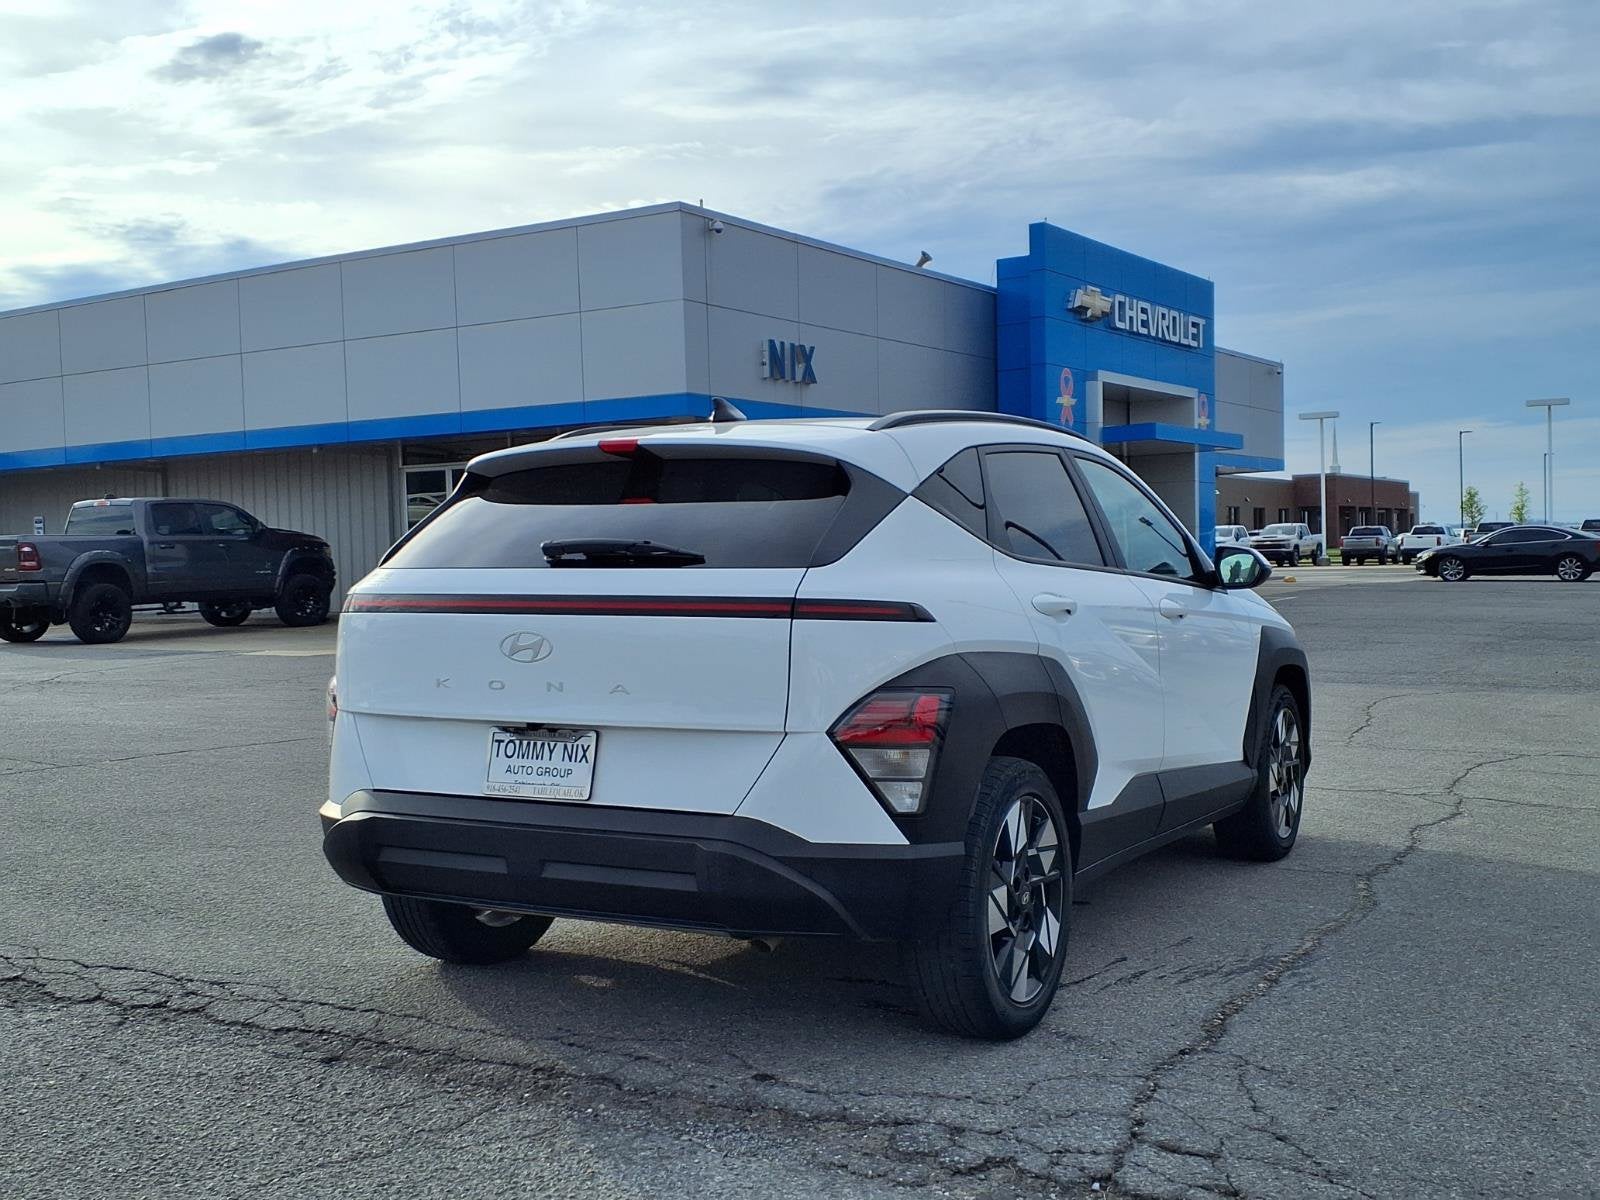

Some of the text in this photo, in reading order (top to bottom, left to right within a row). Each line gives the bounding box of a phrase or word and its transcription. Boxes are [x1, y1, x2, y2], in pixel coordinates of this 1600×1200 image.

[1114, 294, 1206, 348] CHEVROLET
[767, 338, 818, 384] NIX
[435, 677, 631, 695] KONA
[494, 738, 591, 764] TOMMY NIX
[505, 764, 573, 778] AUTO GROUP
